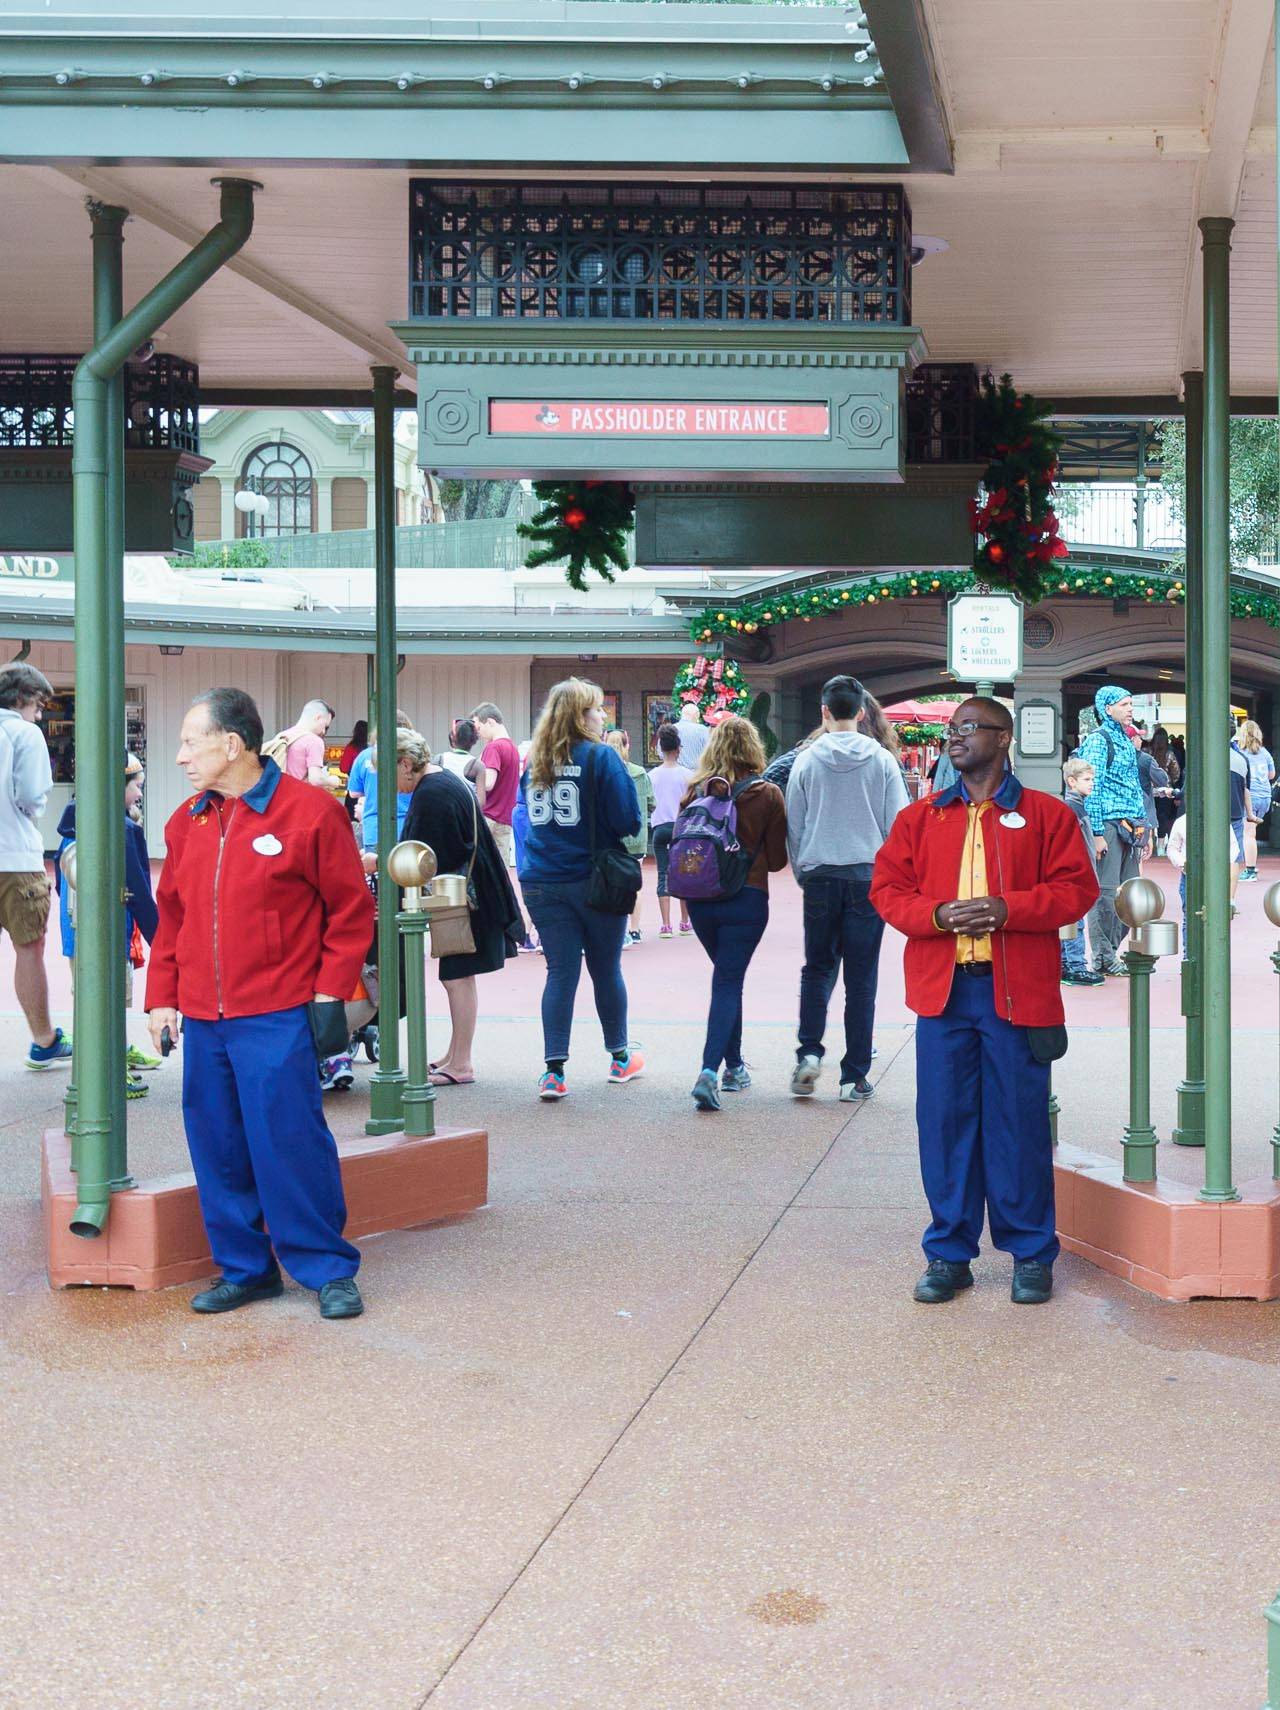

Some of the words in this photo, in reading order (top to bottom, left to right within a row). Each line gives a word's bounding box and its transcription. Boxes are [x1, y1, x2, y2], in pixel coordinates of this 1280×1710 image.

[571, 407, 687, 431] PASSHOLDER
[695, 408, 787, 432] ENTRANCE
[526, 780, 582, 827] 89
